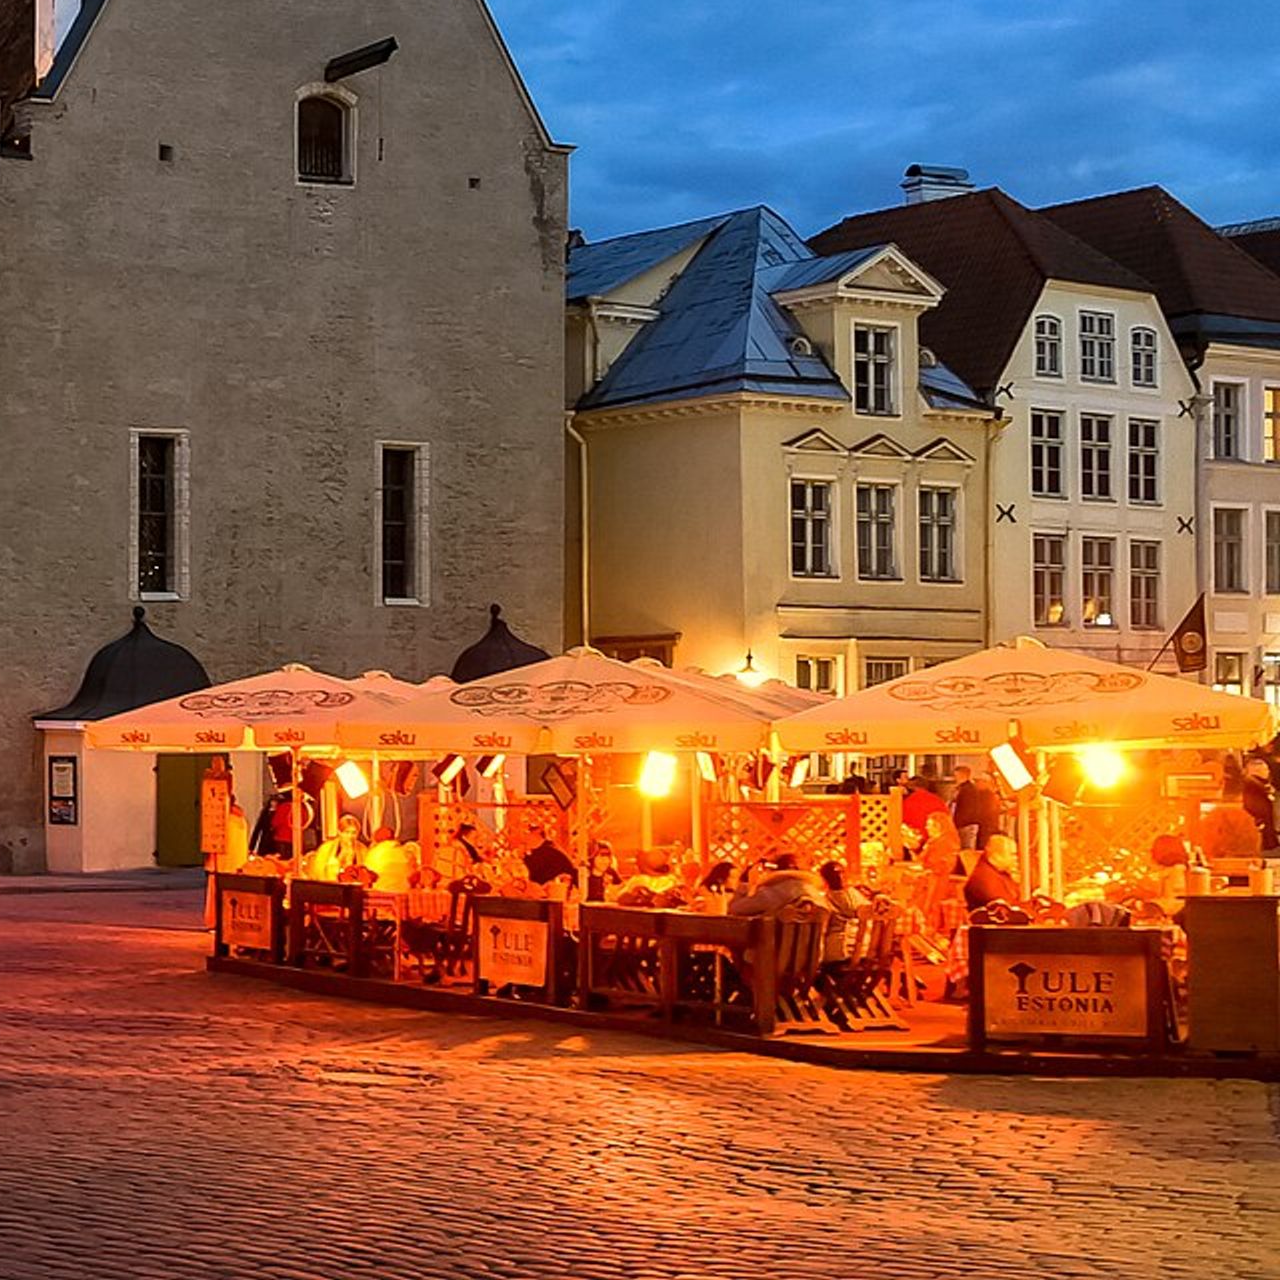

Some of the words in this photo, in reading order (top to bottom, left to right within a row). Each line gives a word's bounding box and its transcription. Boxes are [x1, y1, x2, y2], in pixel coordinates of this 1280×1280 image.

[1172, 712, 1222, 732] saku
[120, 730, 151, 743] saku
[195, 730, 226, 743] saku
[274, 728, 305, 742] saku
[378, 730, 417, 746] saku
[473, 731, 513, 748] saku
[573, 731, 614, 749] saku
[825, 728, 868, 746] saku
[935, 726, 980, 744] saku
[1016, 995, 1114, 1014] ESTONIA
